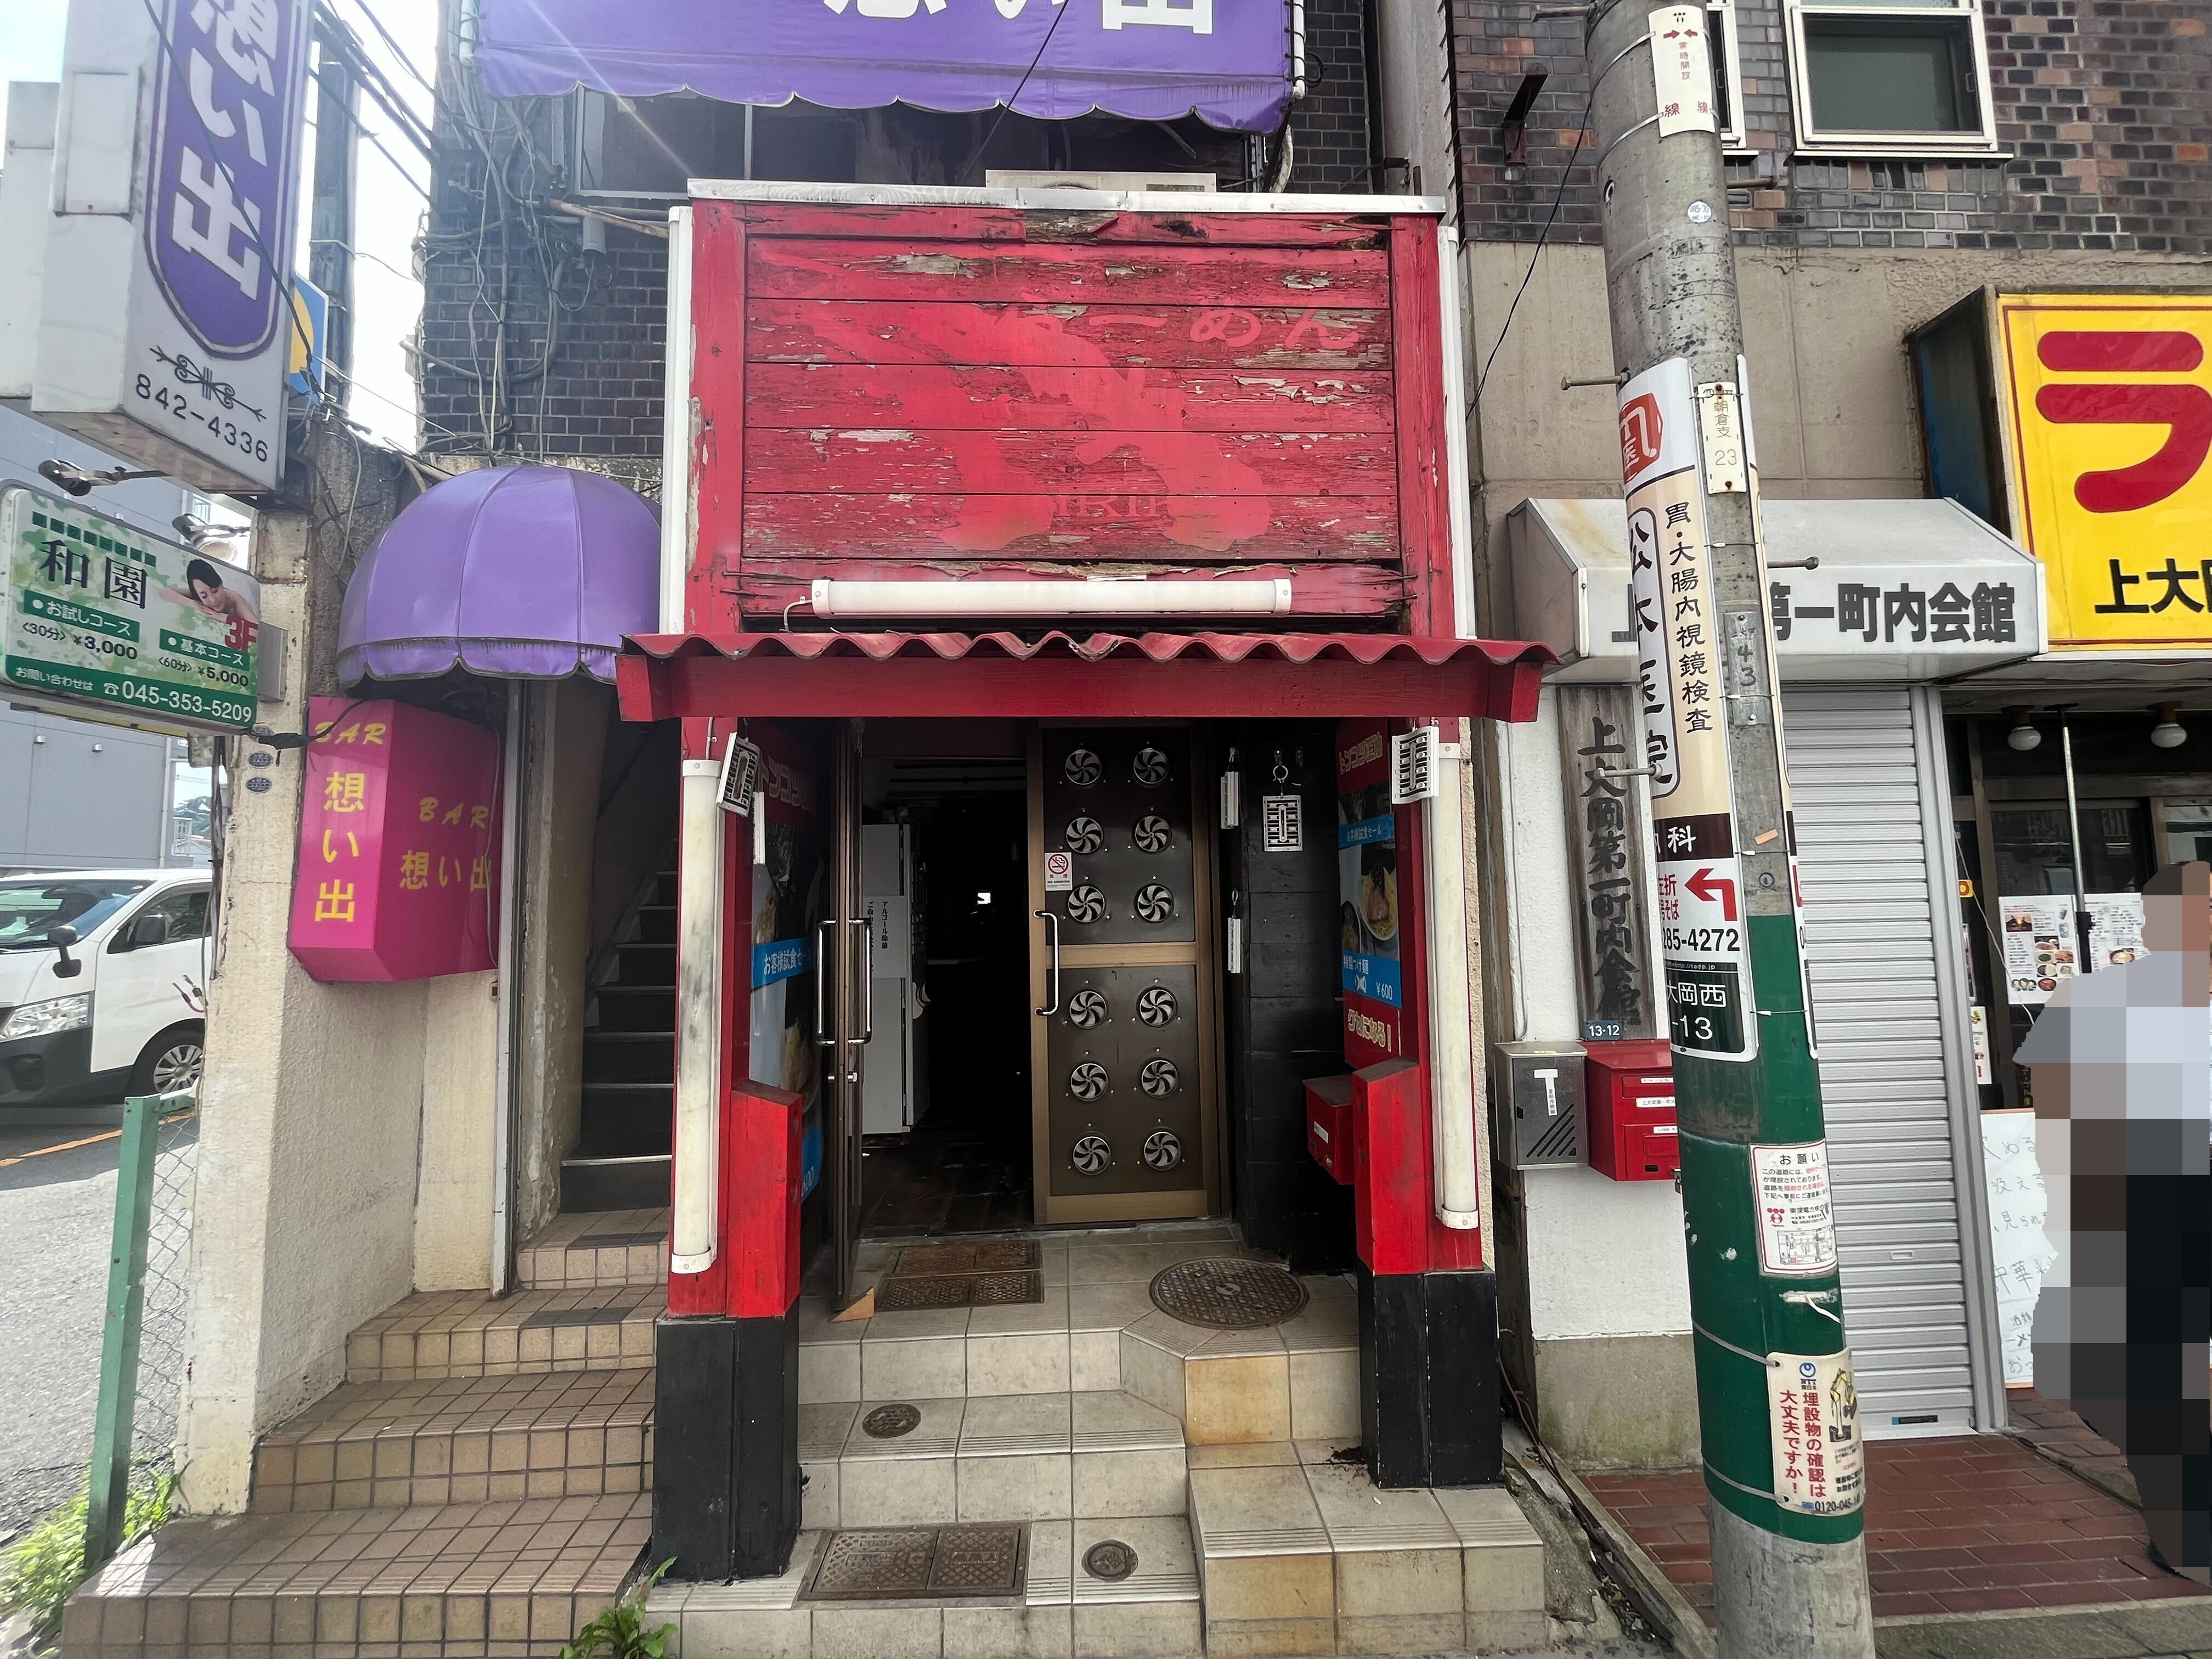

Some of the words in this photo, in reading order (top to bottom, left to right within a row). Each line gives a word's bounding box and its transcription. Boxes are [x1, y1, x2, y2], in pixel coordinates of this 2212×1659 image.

[137, 374, 268, 462] 842-4336
[2036, 331, 2212, 513] ラ
[1715, 449, 1737, 466] 23
[40, 539, 148, 609] 和園
[2095, 558, 2212, 614] 上大
[47, 600, 132, 637] お試しコース
[224, 615, 259, 651] 3F
[180, 638, 244, 667] 基本コース
[15, 666, 93, 692] お問い合わせは
[122, 680, 252, 723] 045-353-5209
[314, 722, 386, 744] BAR
[418, 797, 489, 829] BAR
[314, 771, 365, 922] 想い出
[399, 849, 492, 893] 想い出
[1576, 716, 1641, 1026] 上大岡第一町内会館
[1588, 1023, 1620, 1037] 13-12
[1803, 1391, 1826, 1498] 埋設物の確認は
